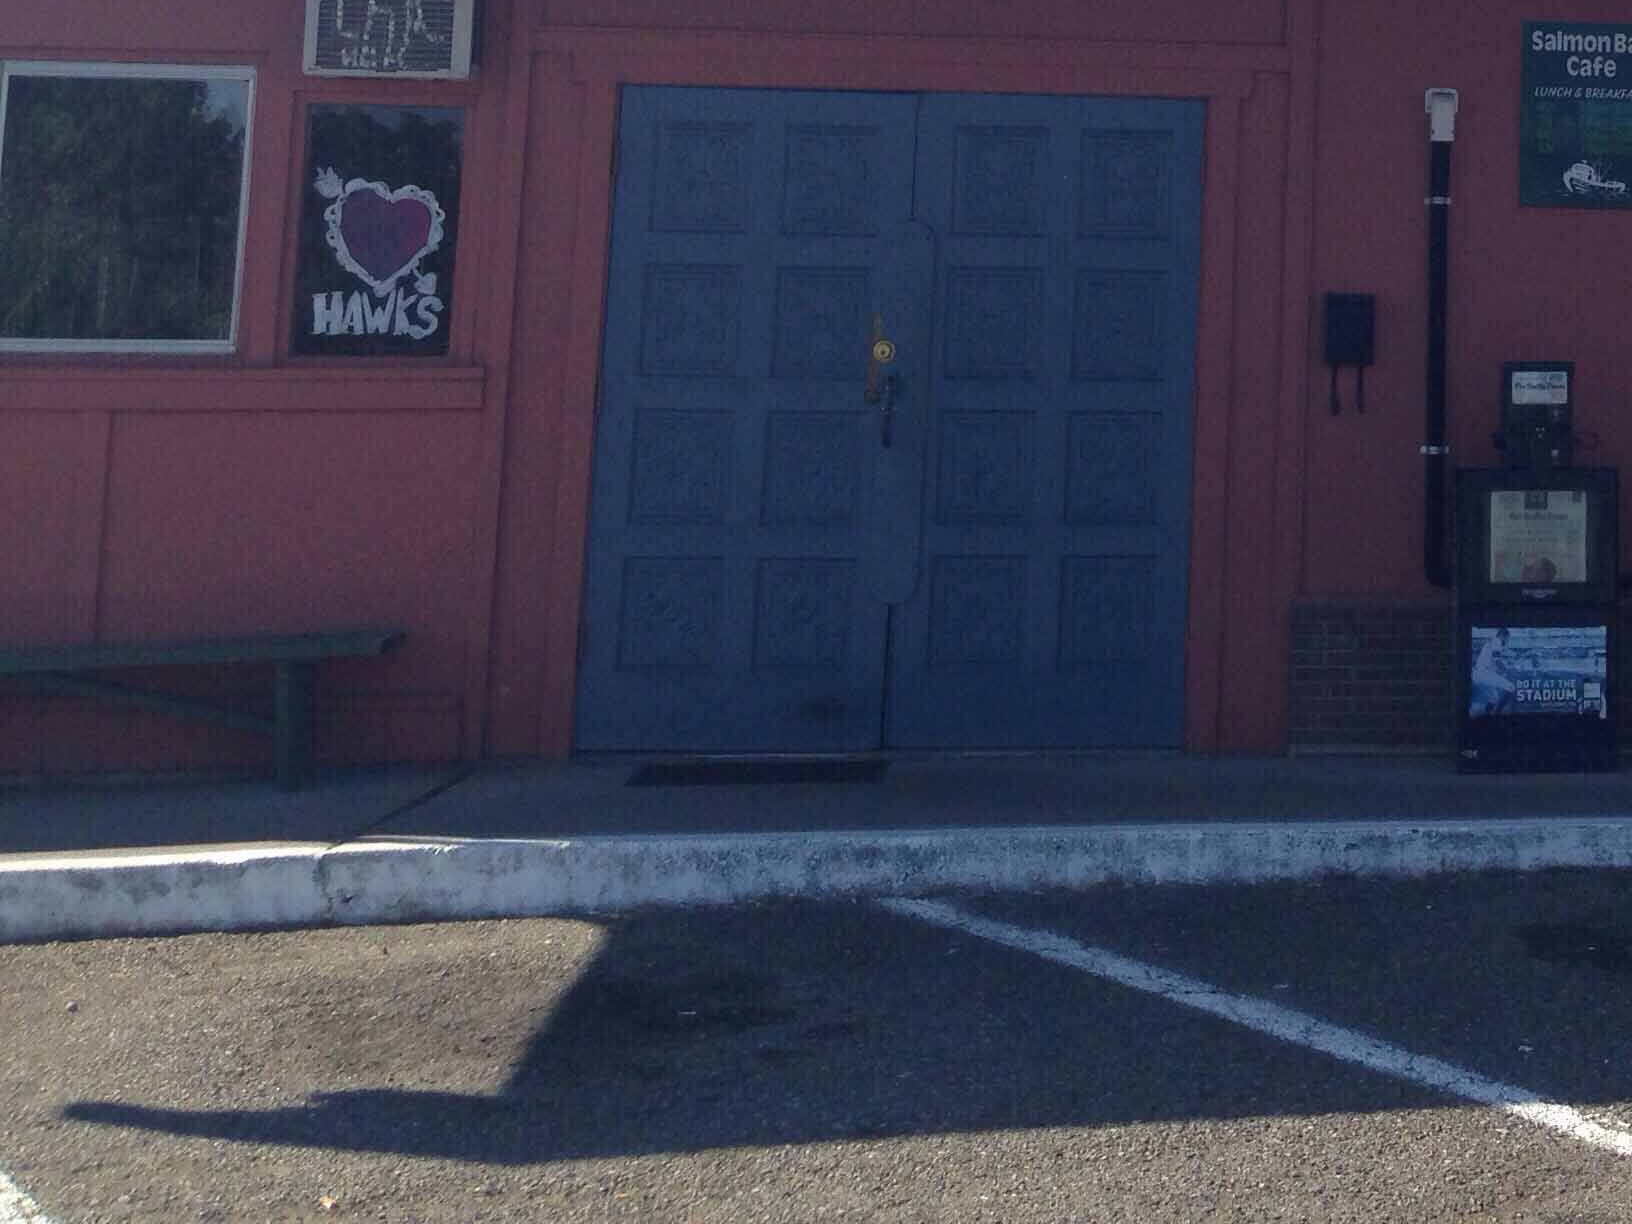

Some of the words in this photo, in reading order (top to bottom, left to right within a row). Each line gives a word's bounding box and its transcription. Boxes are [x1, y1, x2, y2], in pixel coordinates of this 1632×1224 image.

[1531, 30, 1611, 54] Salmon
[1566, 55, 1617, 78] Cafe
[1534, 86, 1573, 98] LUNCH
[311, 289, 445, 338] HAWKS
[1516, 688, 1577, 702] STADIUM
